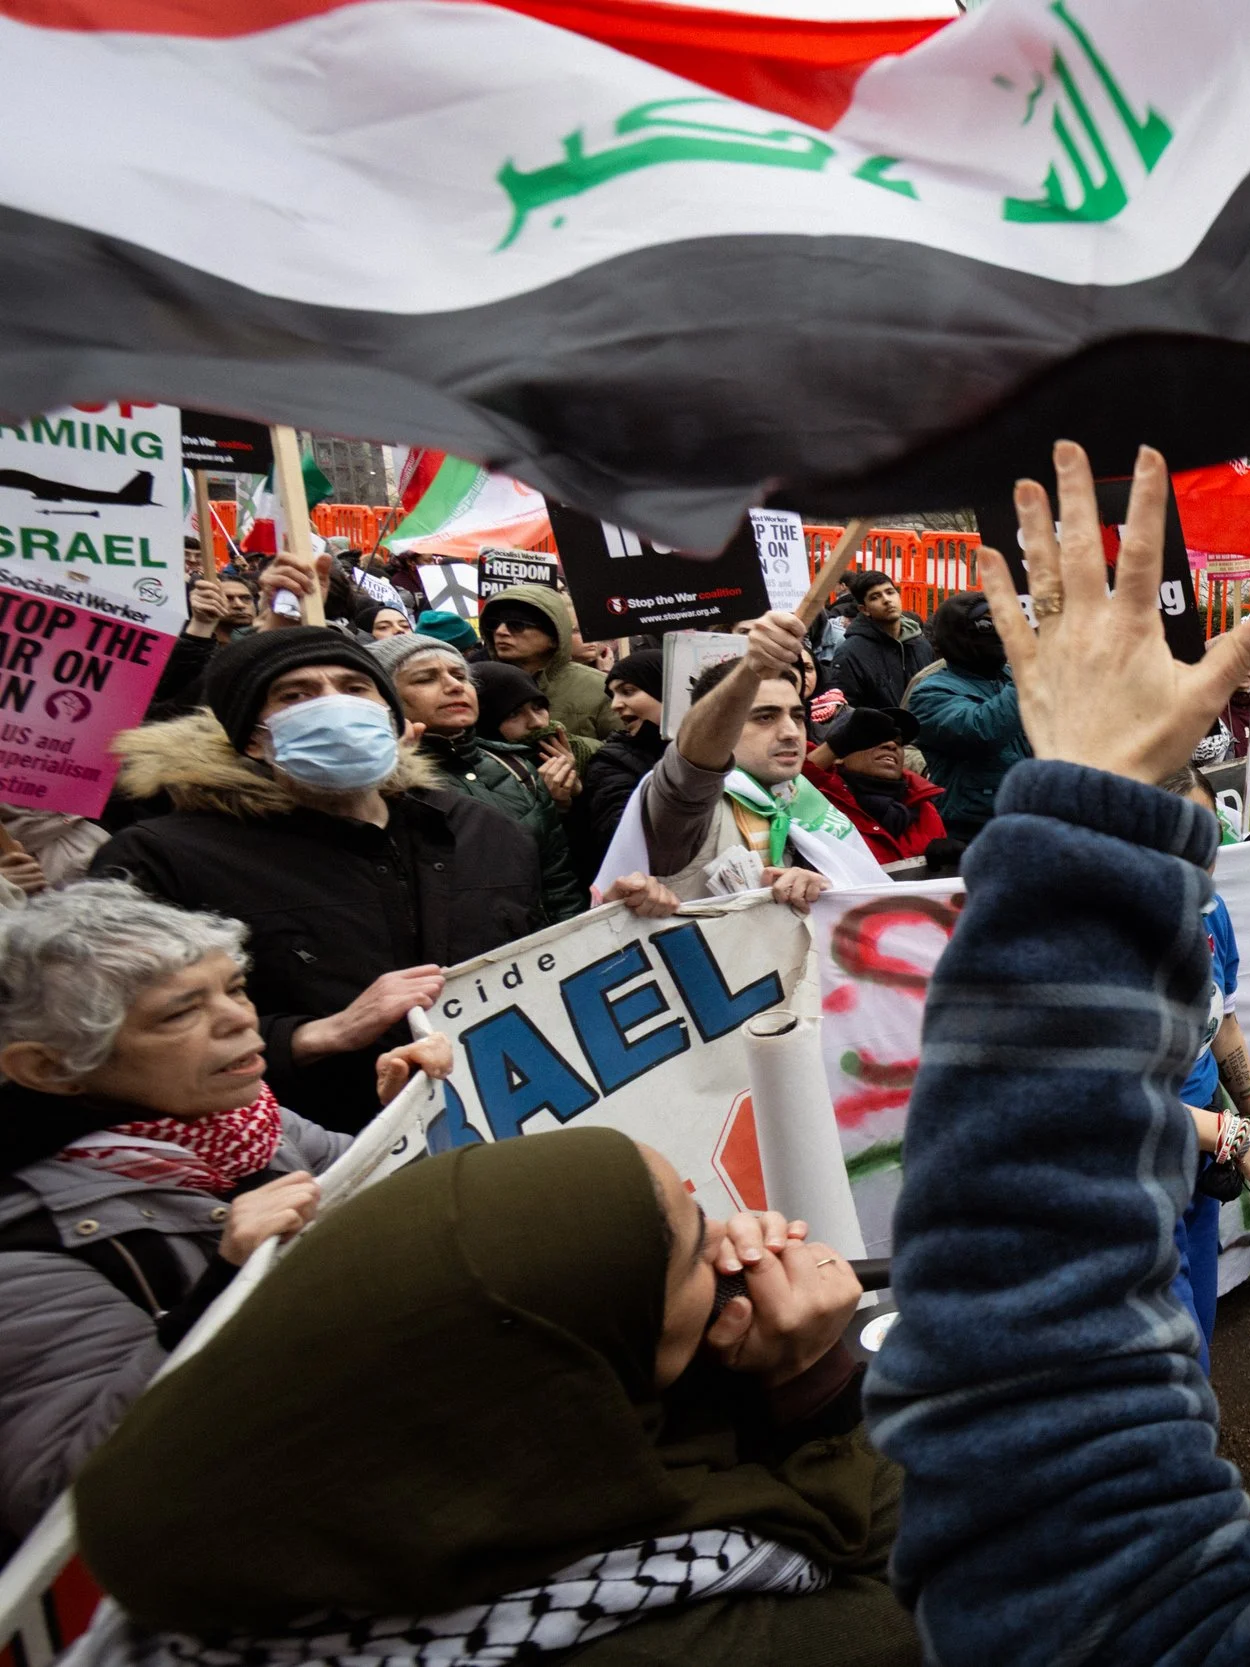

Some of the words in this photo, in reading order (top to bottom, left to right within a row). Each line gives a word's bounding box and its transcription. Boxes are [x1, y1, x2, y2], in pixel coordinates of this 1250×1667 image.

[770, 524, 799, 541] THE
[768, 541, 789, 558] ON
[484, 560, 551, 581] FREEDOM
[83, 592, 151, 624] Worker
[627, 596, 655, 611] Stop
[656, 594, 675, 606] the
[675, 591, 698, 604] War
[698, 586, 742, 600] coalition
[639, 605, 721, 625] www.stopwar.org.uk
[86, 615, 160, 667] THE
[53, 650, 114, 693] ON
[1, 723, 33, 744] US
[36, 735, 75, 755] and
